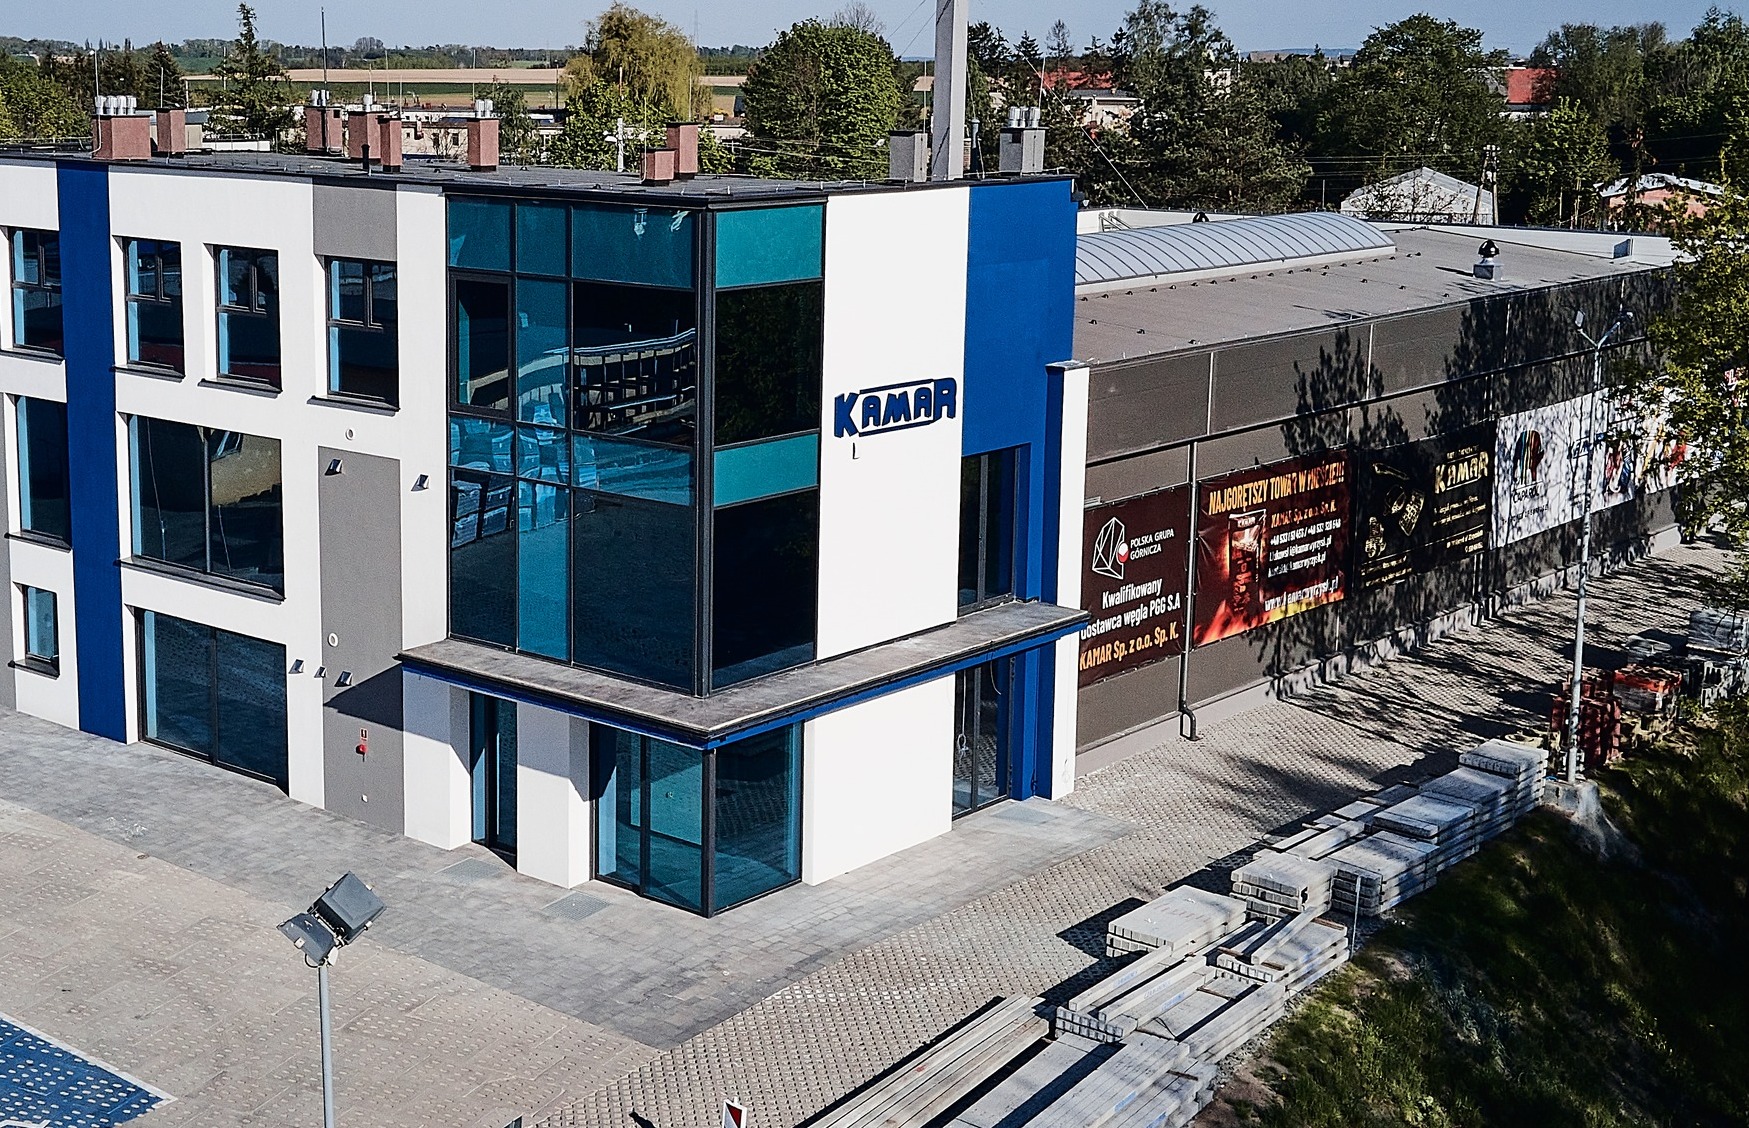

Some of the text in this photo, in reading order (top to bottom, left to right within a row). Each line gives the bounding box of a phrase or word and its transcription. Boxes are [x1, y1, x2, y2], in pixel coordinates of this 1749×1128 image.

[834, 377, 957, 438] KAMAR
[1434, 451, 1489, 494] KAMAR
[1208, 479, 1268, 516] NAJGORĘTSZY
[1270, 472, 1298, 501] TOWAR
[1298, 470, 1308, 491] W
[1130, 528, 1175, 549] POLSKA GRUPA
[1130, 543, 1162, 561] GÓRNICZA
[1102, 578, 1163, 610] Kwalifikowany
[1123, 603, 1148, 627] węgla
[1149, 597, 1166, 618] PGG
[1167, 592, 1181, 610] S.A
[1079, 621, 1179, 671] KAMAR Sp. z o.o. Sp. K.
